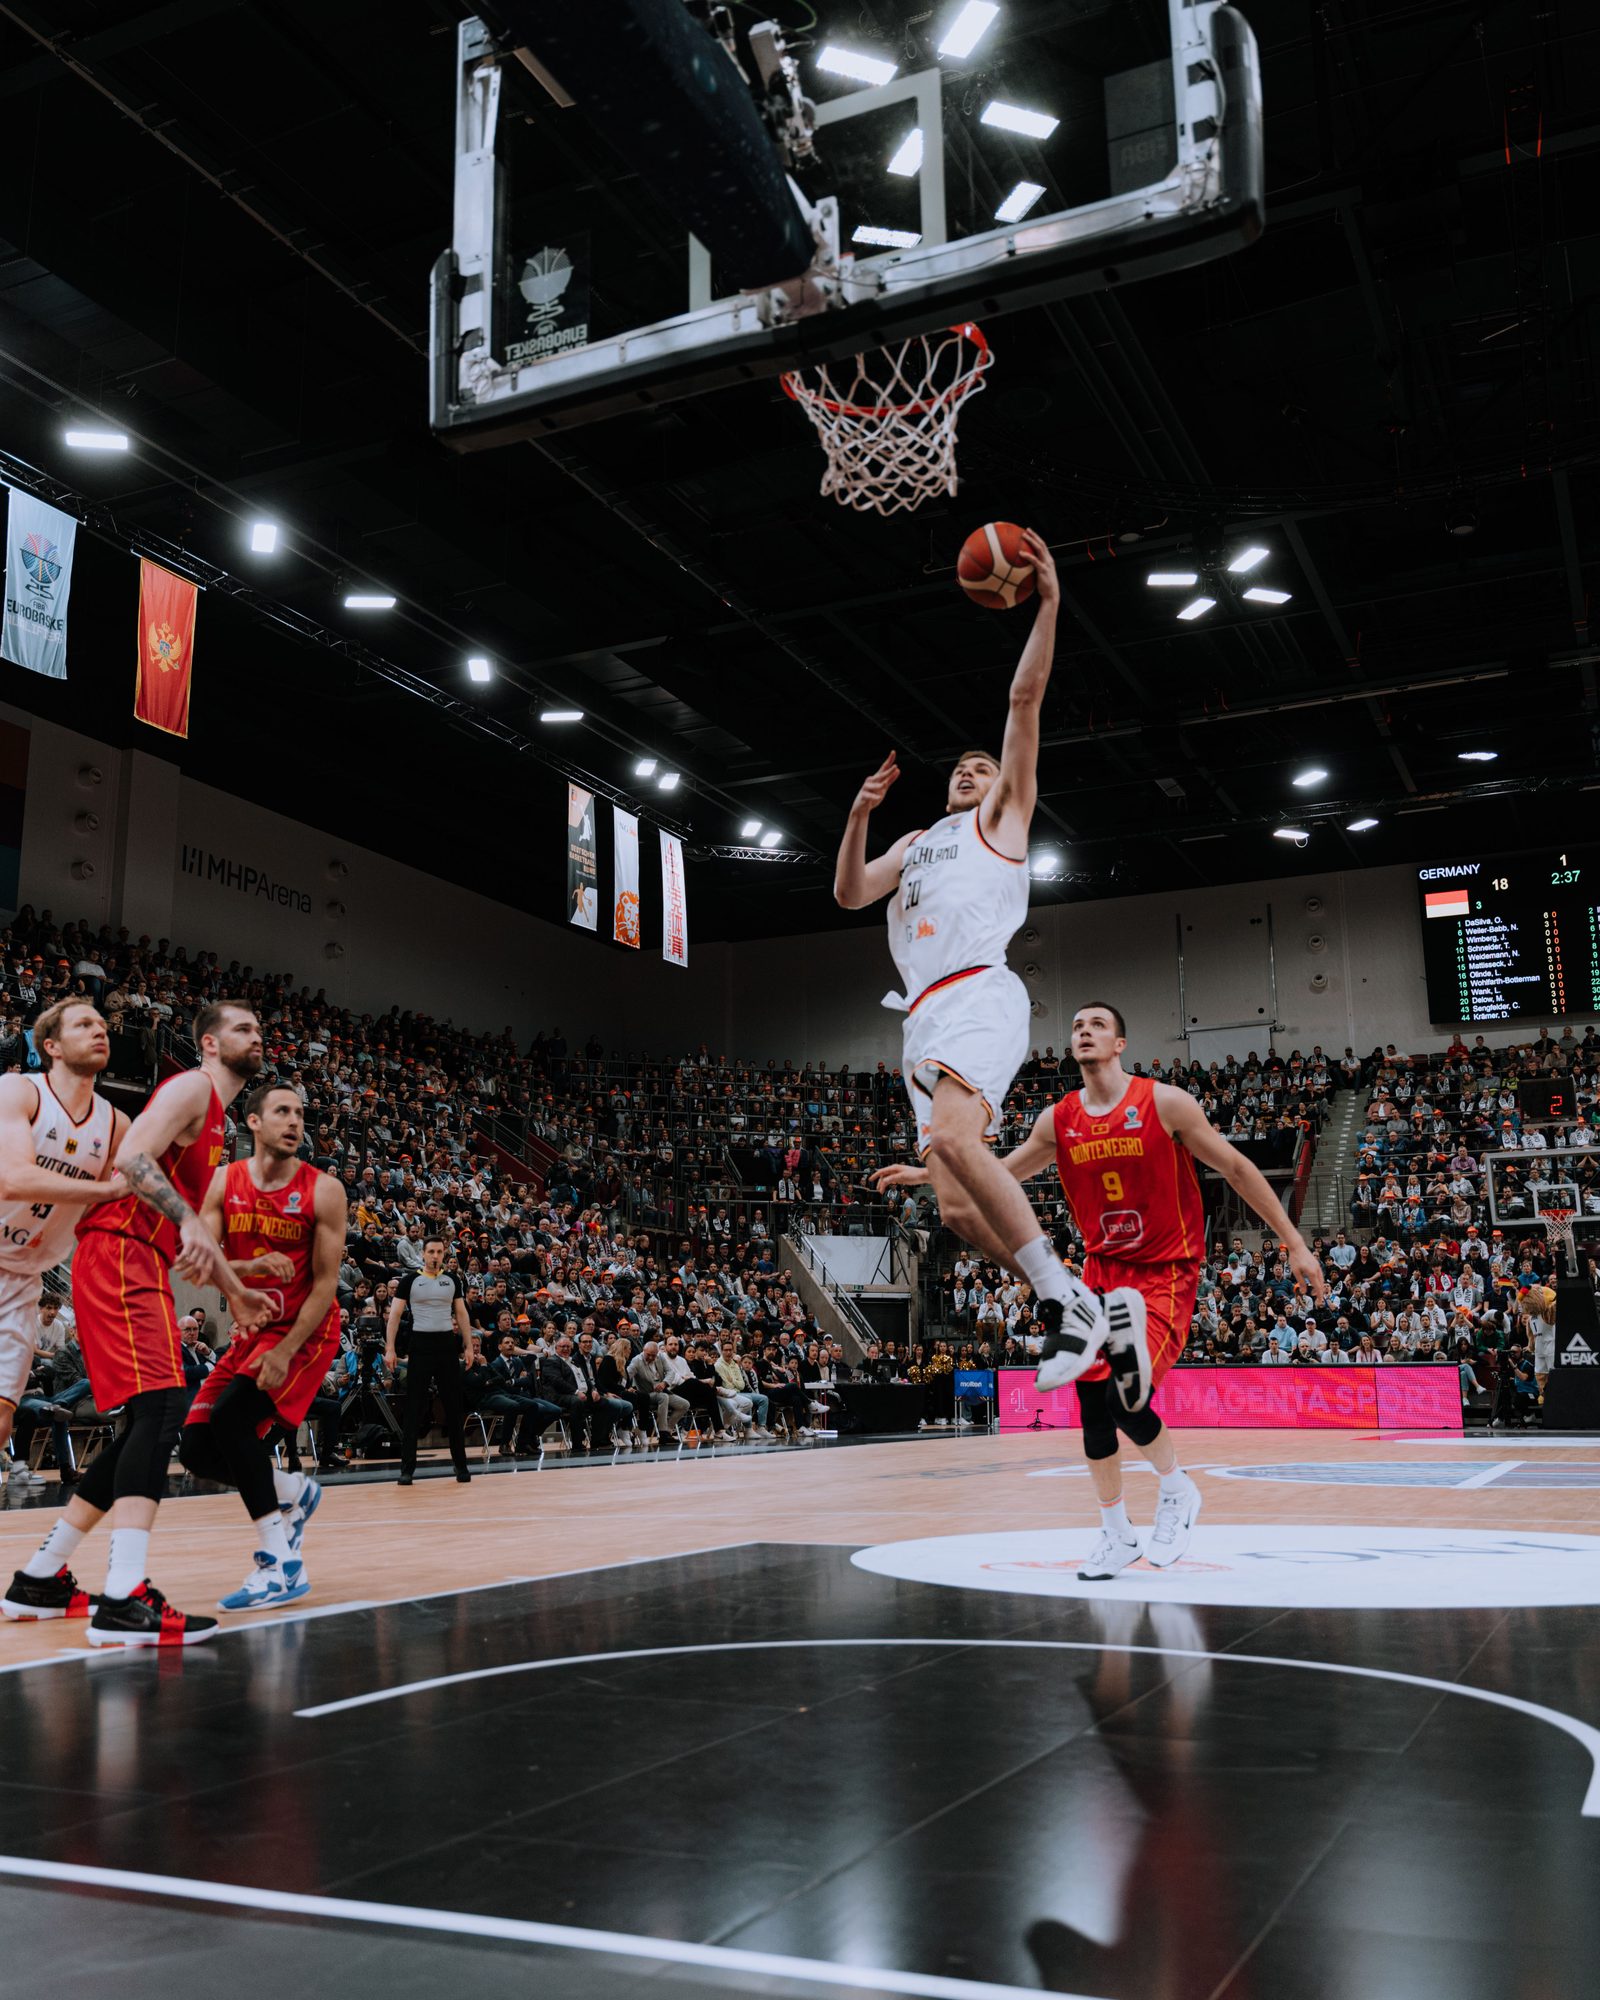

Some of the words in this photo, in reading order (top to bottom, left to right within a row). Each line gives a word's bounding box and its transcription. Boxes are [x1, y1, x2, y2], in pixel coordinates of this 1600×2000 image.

[7, 598, 64, 631] EUROBASKE
[1560, 854, 1566, 866] 1
[1419, 864, 1480, 880] GERMANY
[1551, 870, 1580, 885] 2:37
[1492, 878, 1509, 891] 18
[1476, 901, 1482, 910] 3
[1550, 1096, 1562, 1114] 2
[1070, 1138, 1144, 1165] MONTENEGRO
[1102, 1171, 1124, 1201] 9
[2, 1224, 30, 1246] NG
[1560, 1352, 1599, 1366] PEAK
[1176, 1384, 1331, 1414] MAGENTA
